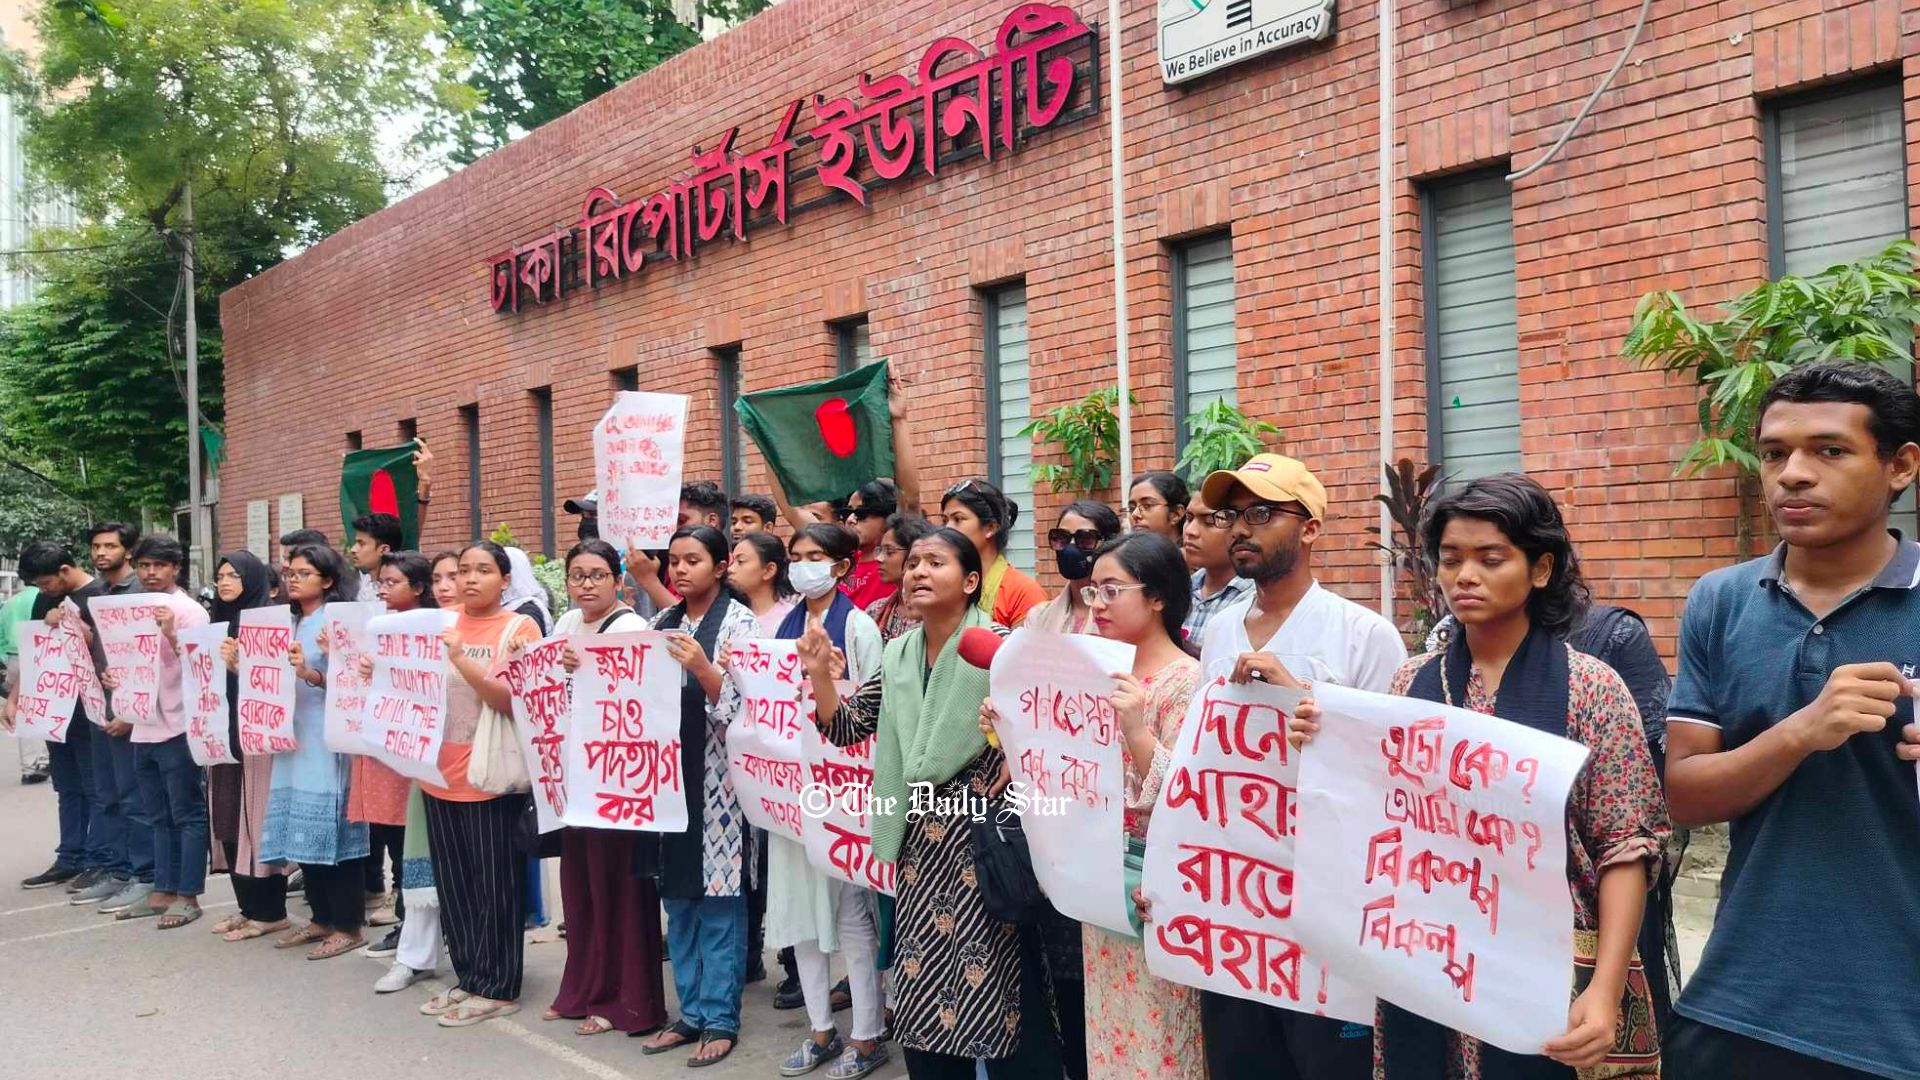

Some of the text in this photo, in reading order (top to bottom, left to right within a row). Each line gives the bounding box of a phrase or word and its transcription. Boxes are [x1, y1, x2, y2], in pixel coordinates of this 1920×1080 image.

[1166, 14, 1321, 79] We Believe in Accuracy
[486, 3, 1093, 313] ঢাকা রিপোর্টার্স ইউনিটি
[377, 633, 410, 656] SAVE
[415, 634, 443, 661] THE
[731, 644, 800, 684] আইন তু
[251, 666, 281, 695] সেনা
[390, 667, 444, 704] COUNTRY
[373, 696, 409, 724] JOIN
[412, 704, 438, 729] THE
[596, 699, 644, 740] চাও
[1191, 676, 1290, 766] দিনে
[584, 739, 681, 795] পদত্যাগ
[596, 792, 655, 826] কর
[1384, 785, 1461, 838] আমি
[1177, 843, 1293, 919] রাতে
[1365, 826, 1500, 936] বিকল্প
[1359, 894, 1475, 1002] বিকল্প
